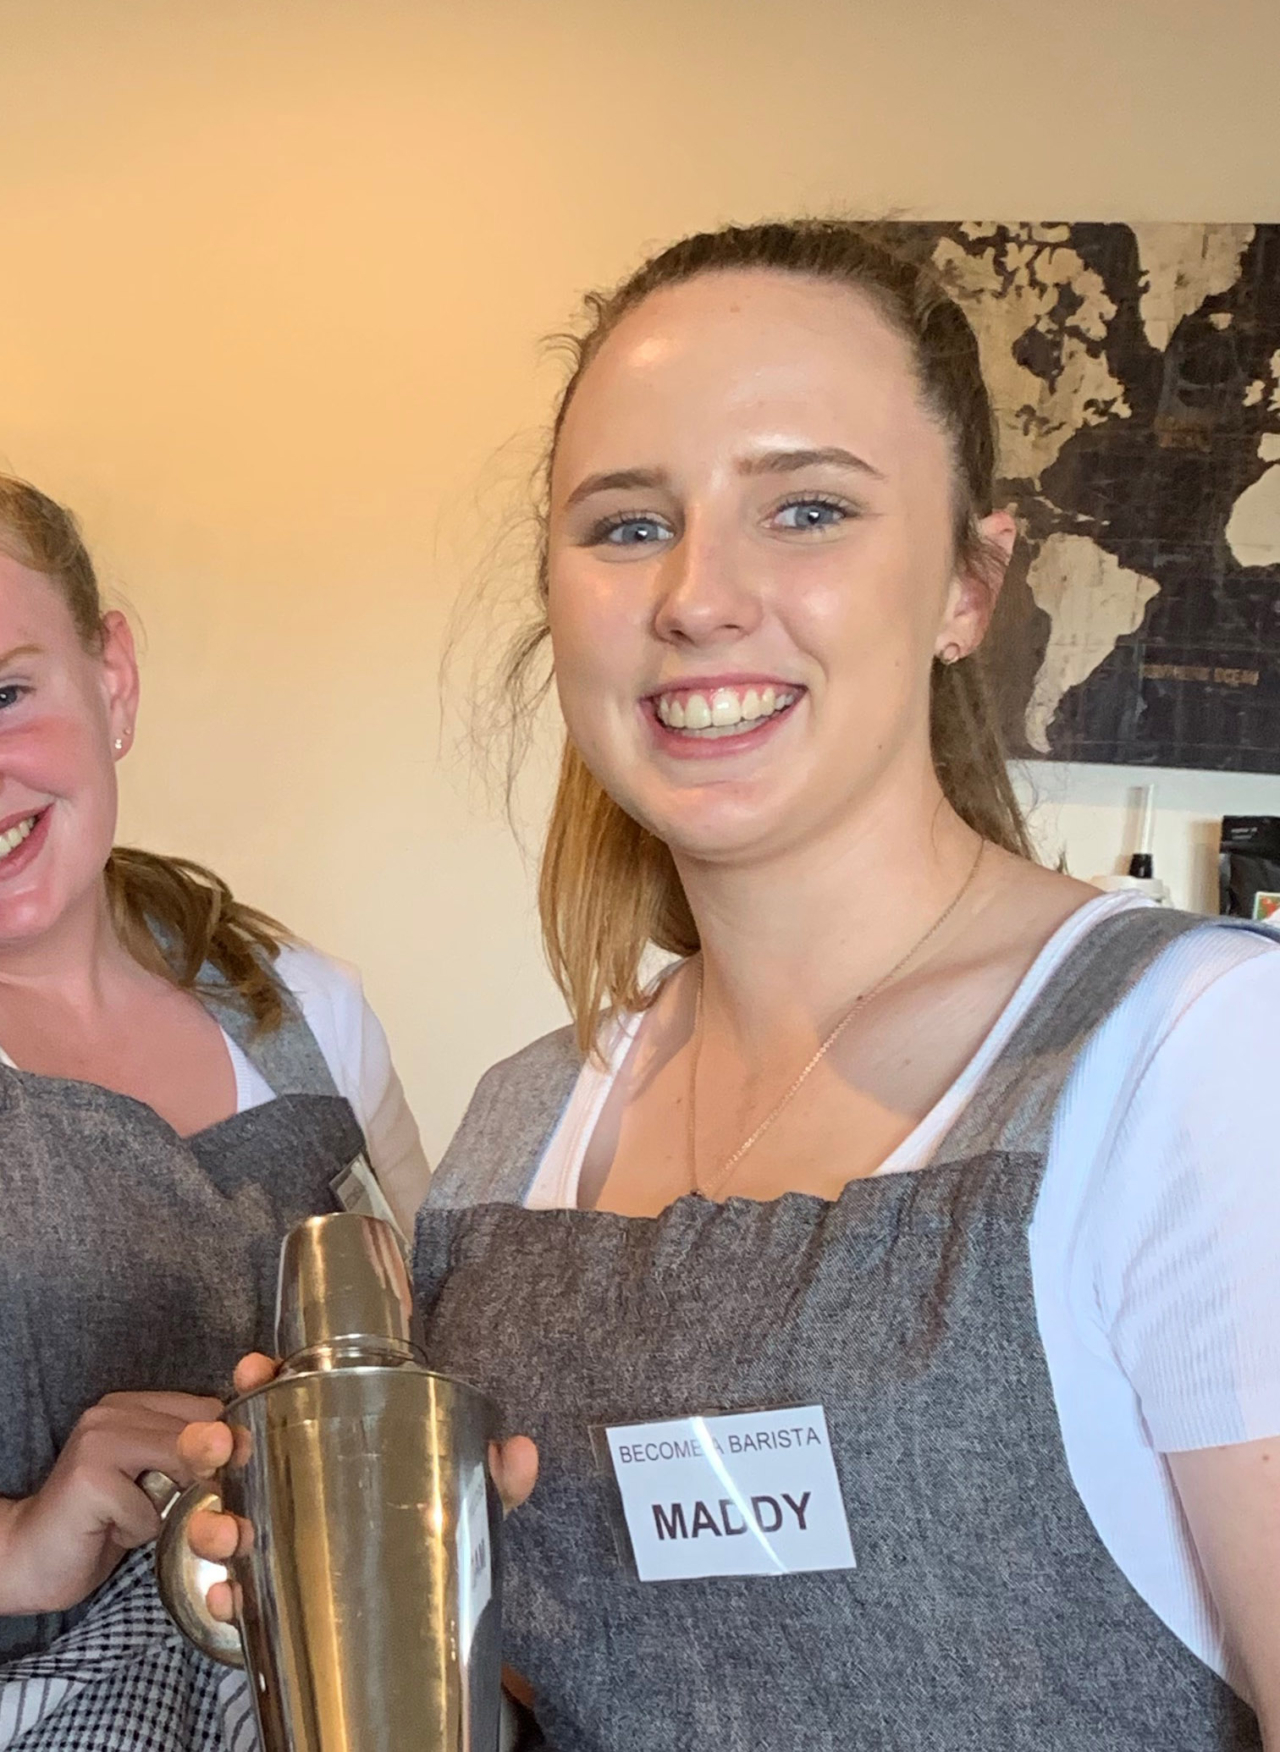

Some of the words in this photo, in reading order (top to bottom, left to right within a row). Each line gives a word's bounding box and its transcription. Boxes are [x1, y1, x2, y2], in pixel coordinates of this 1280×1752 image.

[618, 1439, 702, 1464] BECOME
[728, 1426, 821, 1454] BARISTA
[651, 1491, 812, 1541] MADDY
